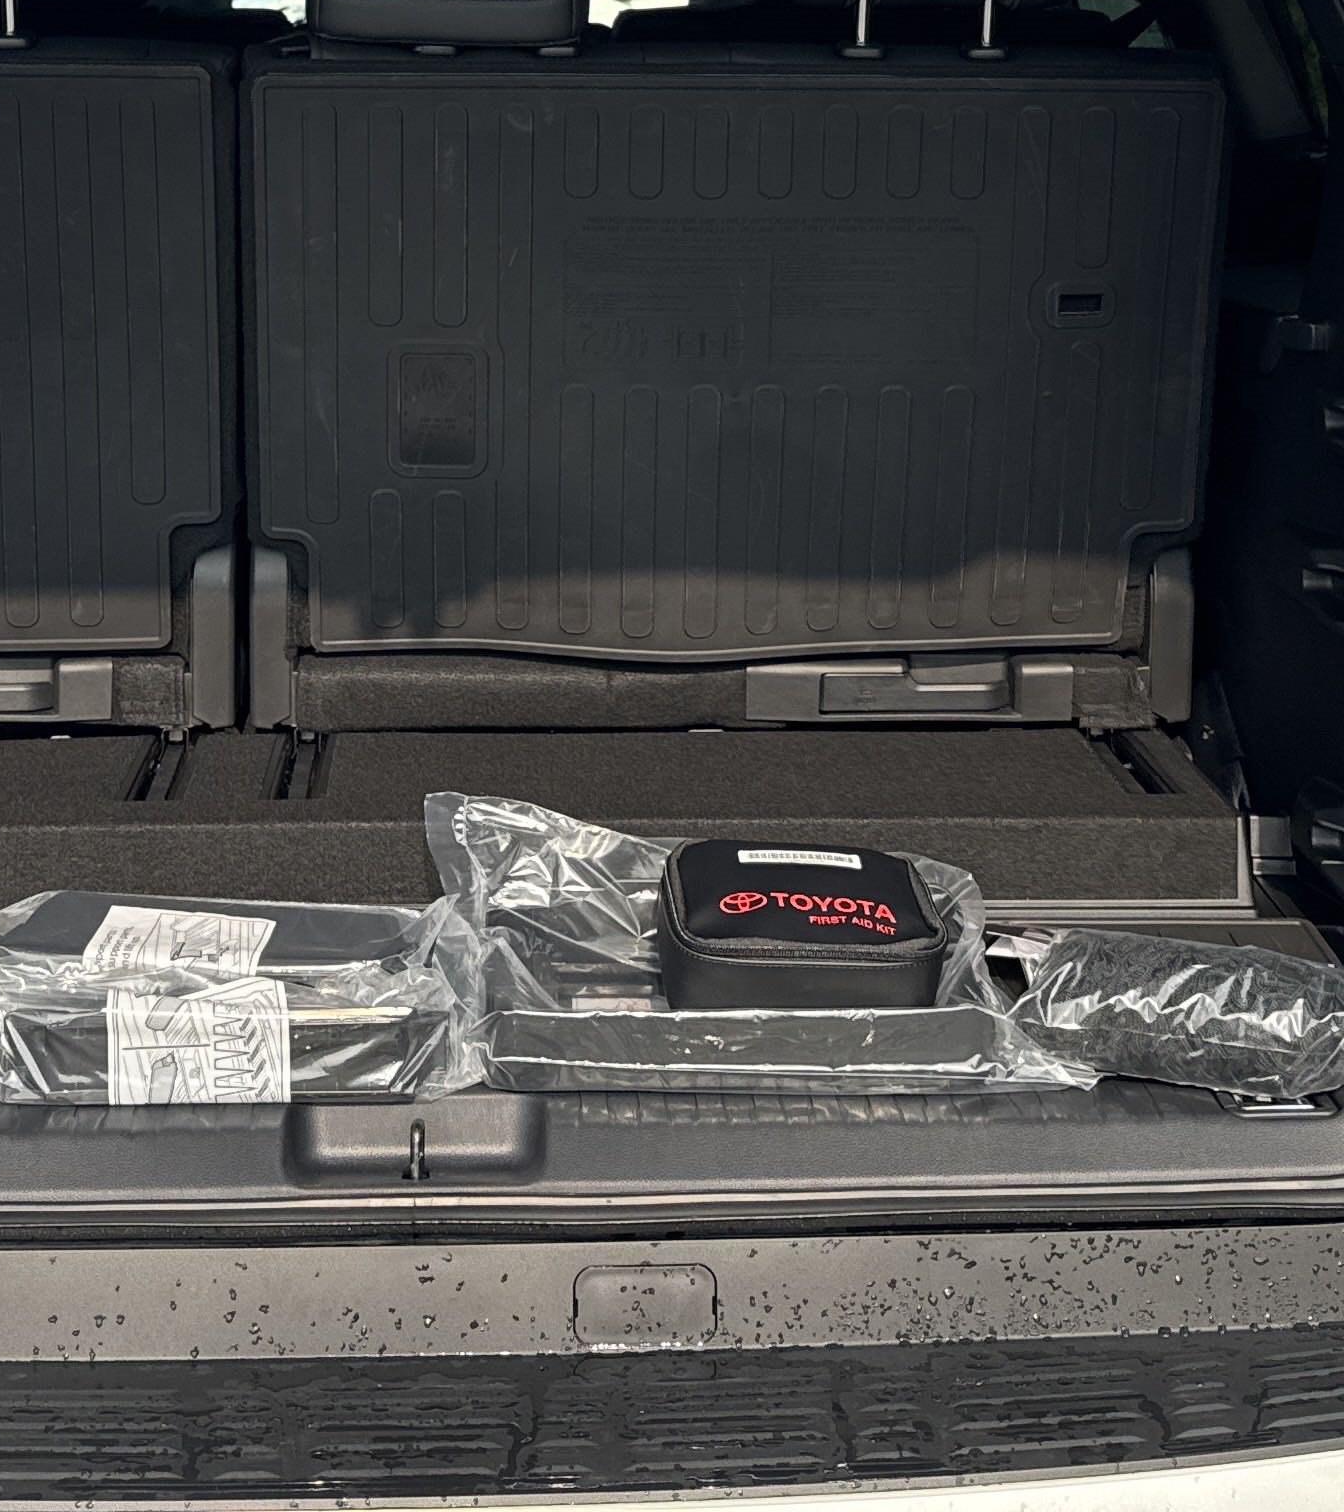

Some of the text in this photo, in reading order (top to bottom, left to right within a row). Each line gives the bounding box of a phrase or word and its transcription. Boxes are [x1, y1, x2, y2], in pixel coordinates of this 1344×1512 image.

[770, 892, 897, 923] TOYOTA
[808, 915, 897, 935] FIRST AID KIT
